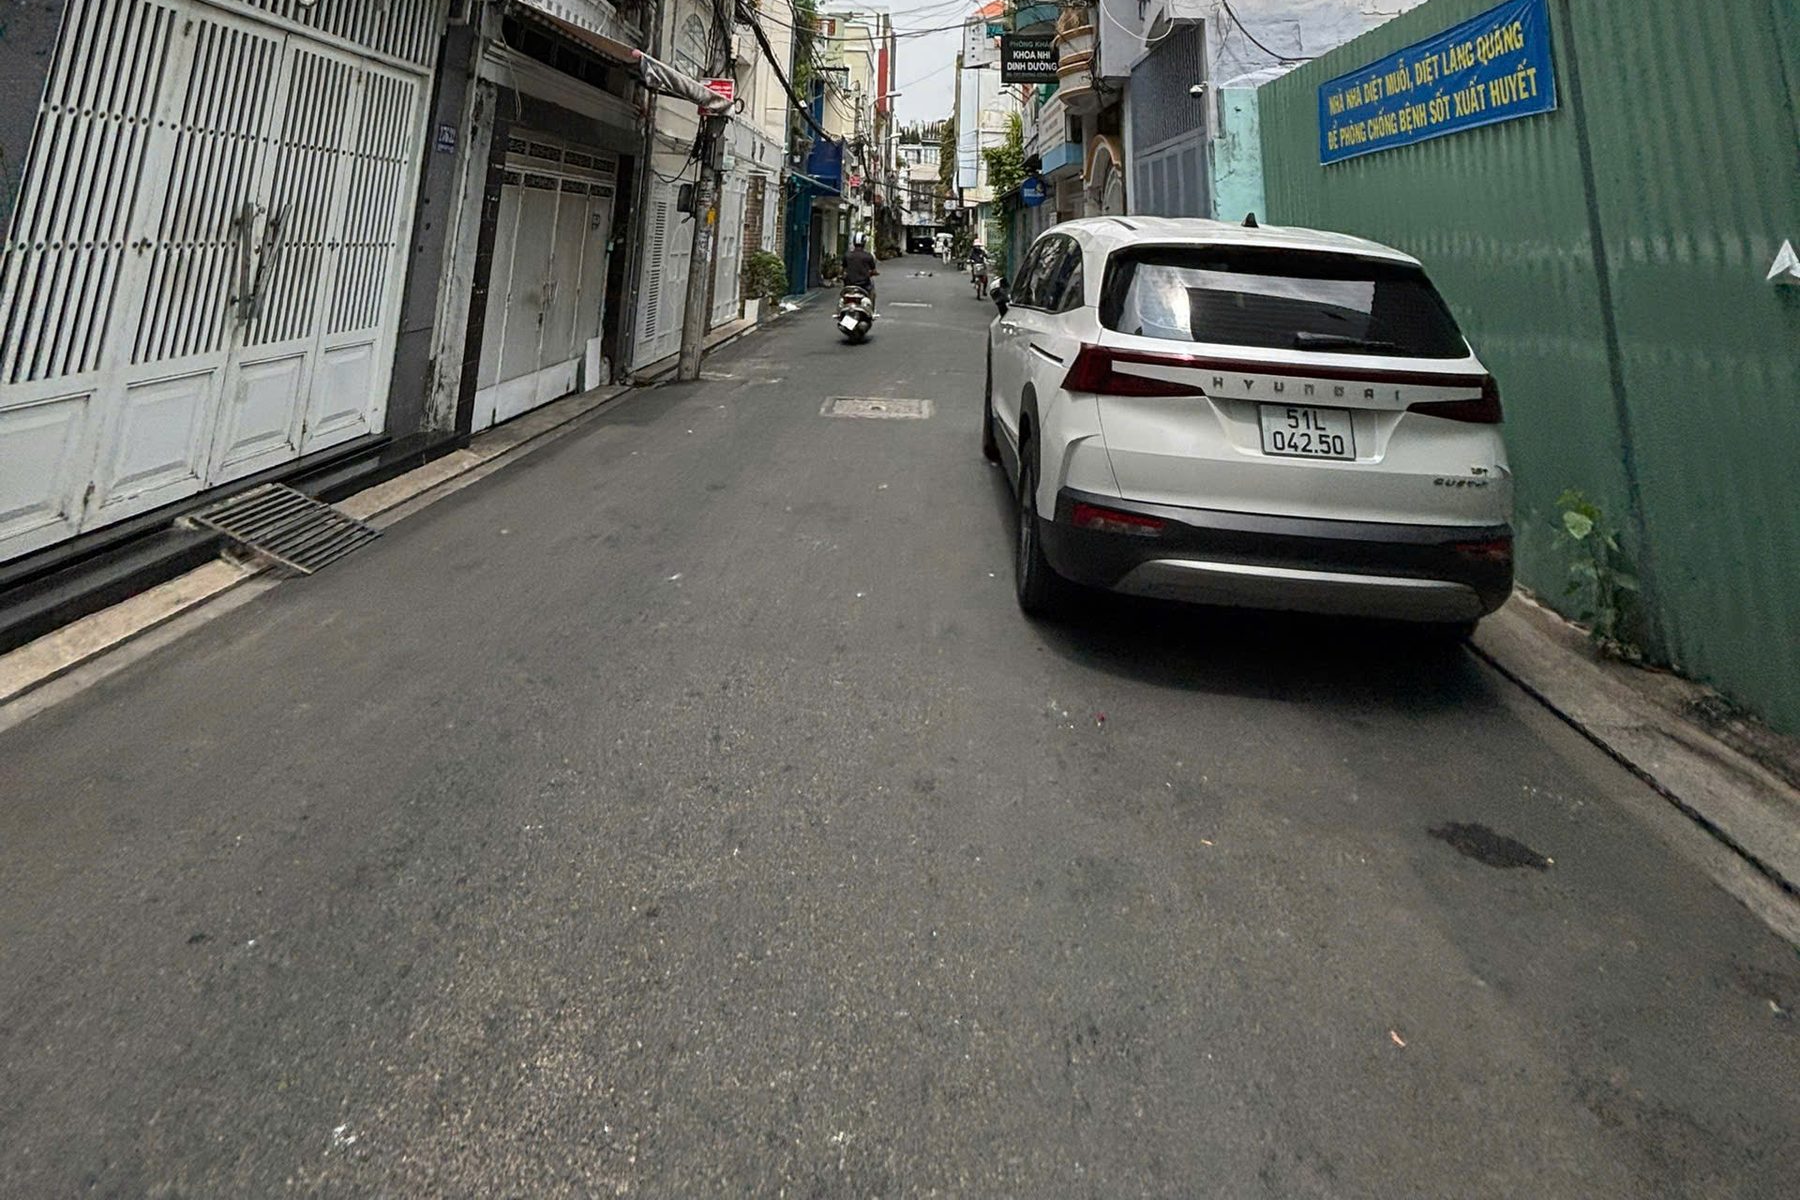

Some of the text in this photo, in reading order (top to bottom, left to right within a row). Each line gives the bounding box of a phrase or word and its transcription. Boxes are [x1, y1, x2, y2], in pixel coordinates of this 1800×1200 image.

[1007, 61, 1026, 71] DINH
[1013, 50, 1051, 59] KHOA NHI
[1329, 20, 1525, 116] NHÀ NHÀ DIỆT MUỖI, DIỆT LĂNG QUĂNG
[1328, 58, 1538, 150] ĐỂ PHÒNG CHỐNG BỆNH SỐT XUẤT HUYẾT
[1212, 376, 1400, 402] HYUNDAI
[1286, 408, 1327, 432] 51L
[1273, 431, 1346, 456] 042.50
